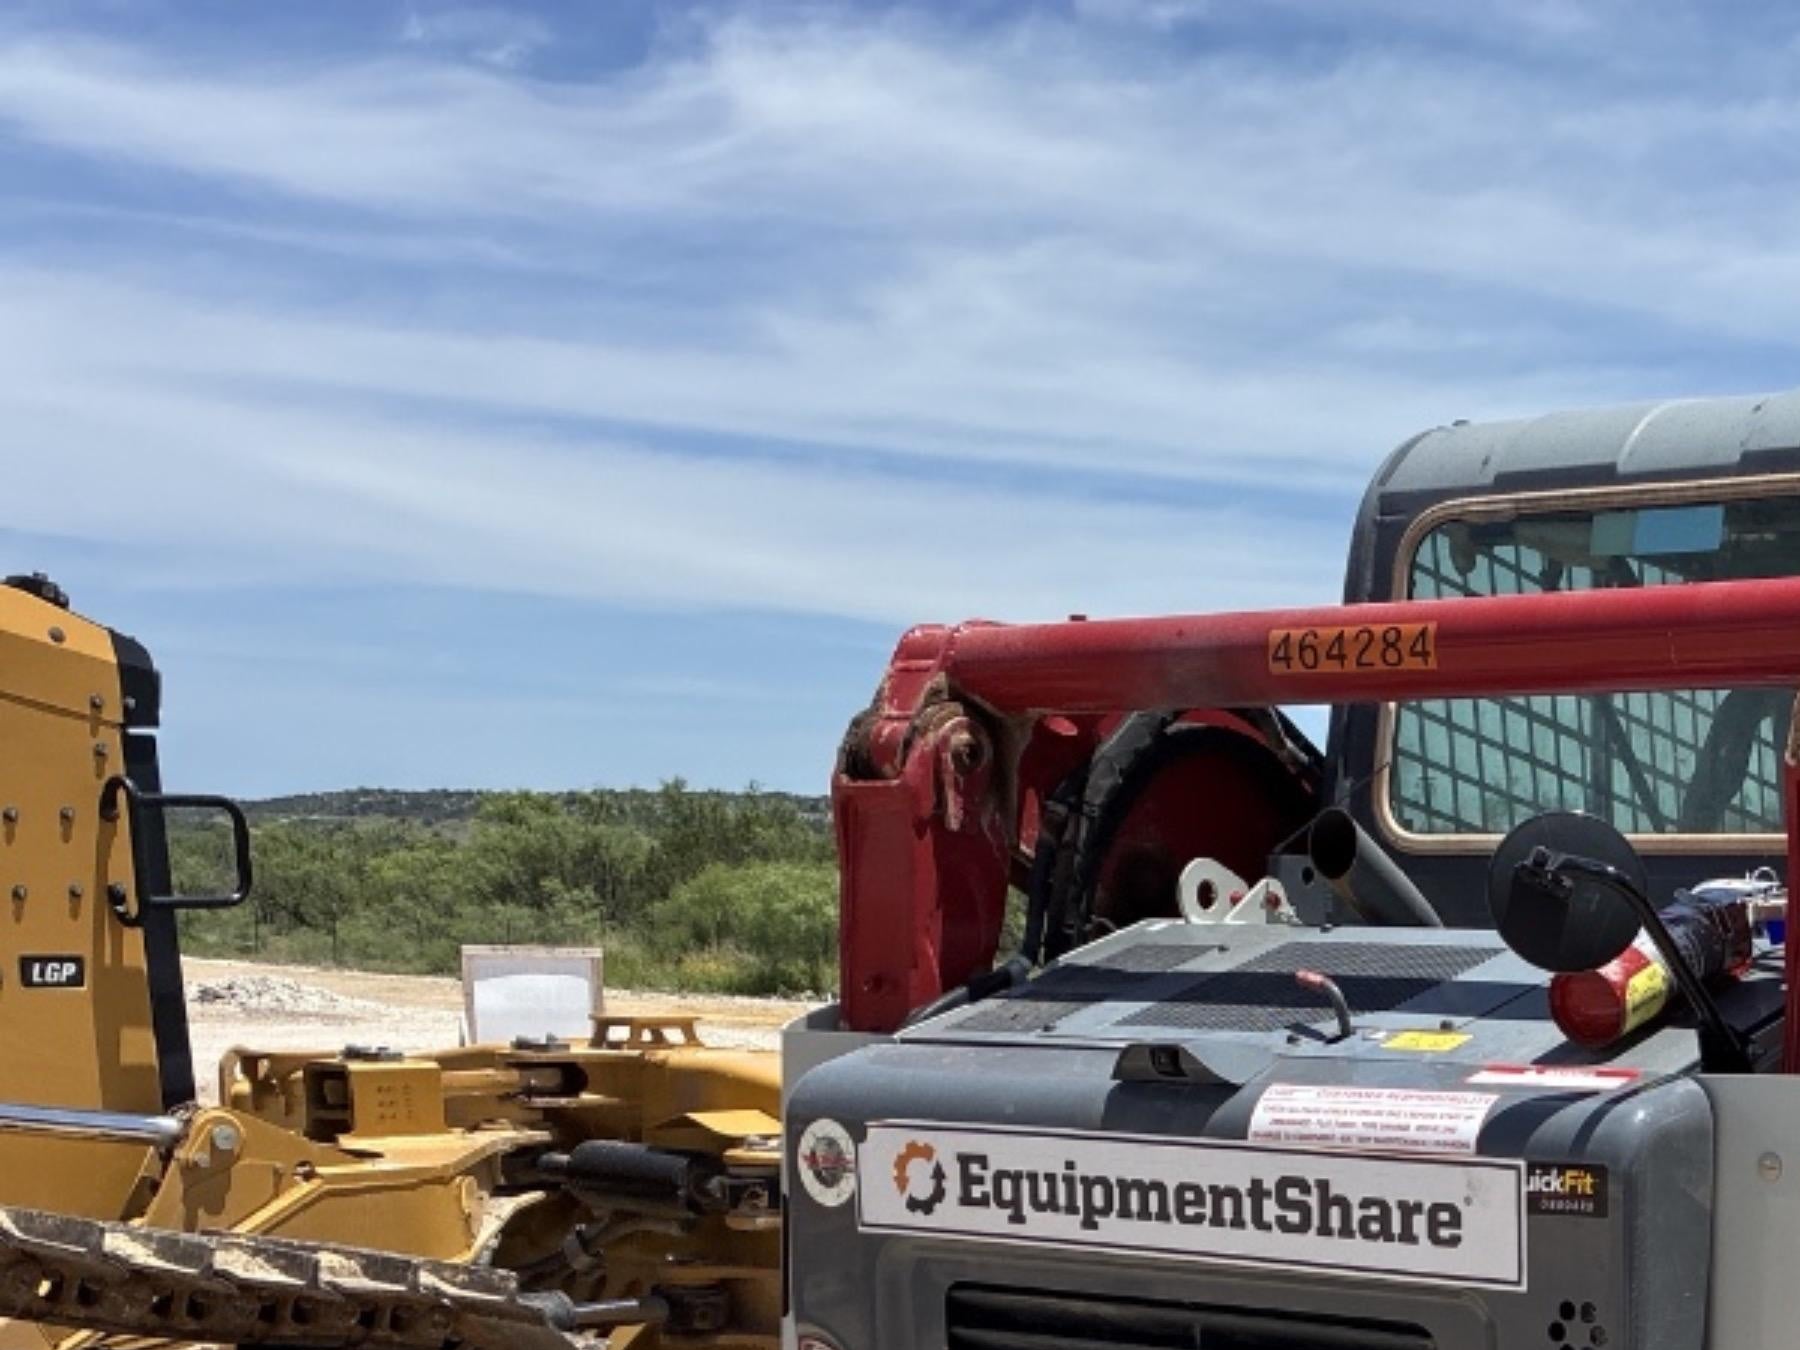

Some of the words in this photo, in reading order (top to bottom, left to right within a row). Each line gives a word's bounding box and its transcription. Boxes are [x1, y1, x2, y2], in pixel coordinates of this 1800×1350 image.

[1271, 625, 1432, 671] 464284
[31, 961, 77, 984] LGP
[955, 1151, 1464, 1249] EquipmentShare
